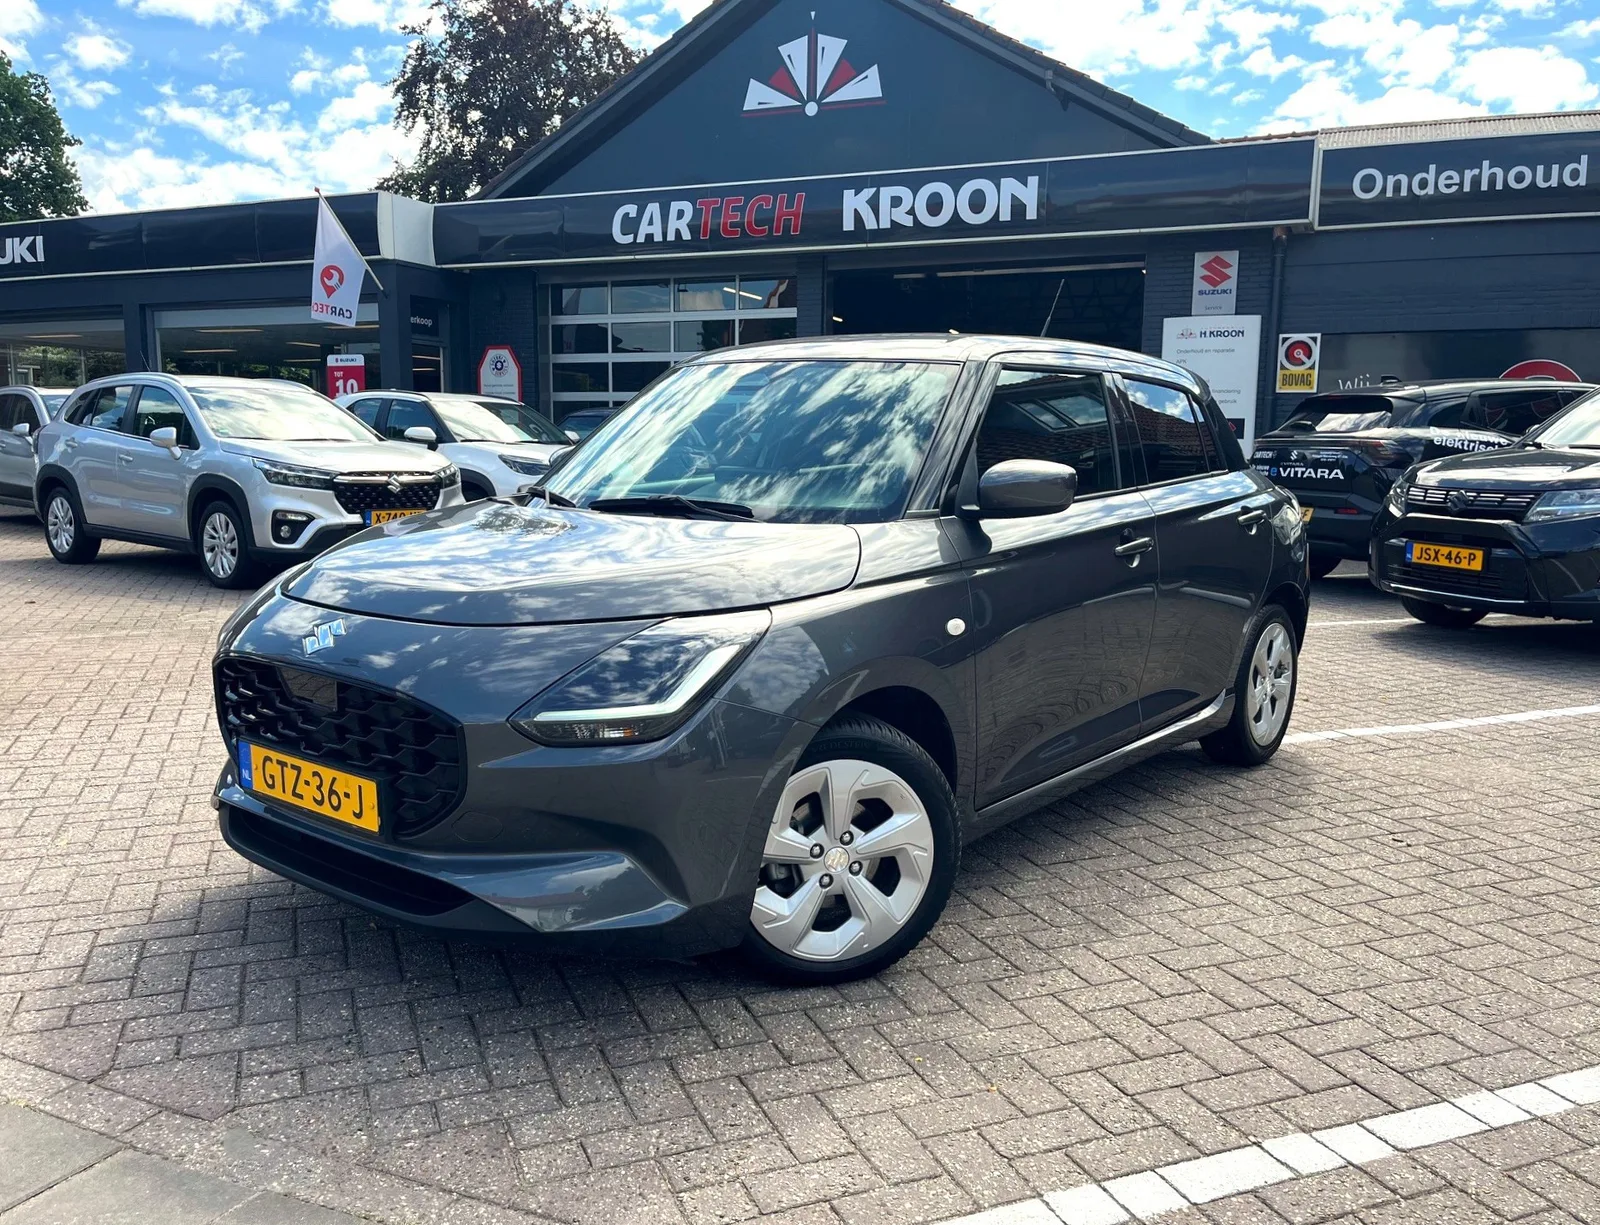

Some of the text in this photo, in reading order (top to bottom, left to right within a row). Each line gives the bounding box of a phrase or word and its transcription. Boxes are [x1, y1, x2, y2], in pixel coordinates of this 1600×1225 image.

[1352, 154, 1588, 199] Onderhoud
[612, 175, 1039, 244] CARTECH KROON
[1209, 329, 1245, 338] KROON
[1281, 373, 1312, 387] BOVAG
[1279, 467, 1345, 480] VITARA
[1416, 547, 1476, 566] JSX-46-P
[242, 755, 364, 820] NL GTZ-36-J
